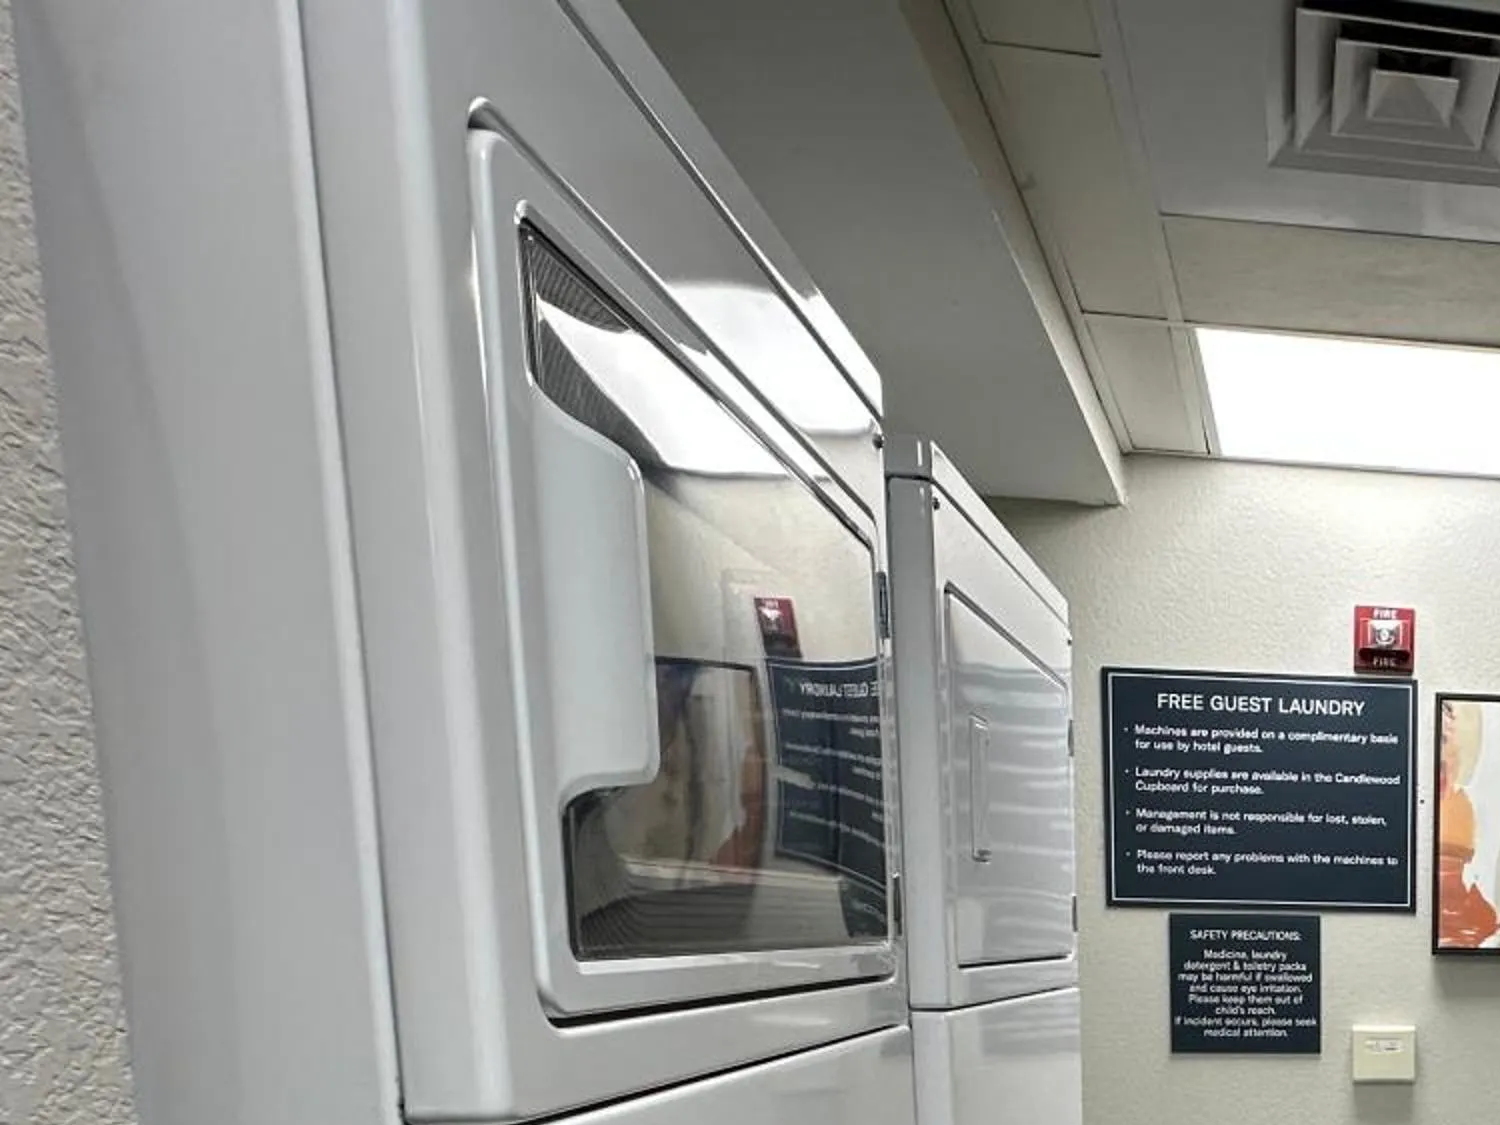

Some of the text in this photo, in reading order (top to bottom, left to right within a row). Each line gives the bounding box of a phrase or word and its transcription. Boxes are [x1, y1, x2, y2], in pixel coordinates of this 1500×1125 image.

[1373, 608, 1398, 619] FIRE
[1373, 656, 1397, 667] FIRE
[1157, 693, 1365, 716] FREE GUEST LAUNDRY
[1135, 724, 1398, 745] Machines are provided on a complimentary basis
[1135, 739, 1264, 755] for use by hotel guests.
[1135, 766, 1401, 785] Laundry supplies are available in the Candlewood
[1135, 780, 1264, 796] Cupboard for purchase.
[1136, 808, 1387, 827] Management is not responsible for lost, stolen,
[1135, 822, 1237, 836] or damaged items.
[1137, 849, 1398, 865] Please report any problems with the machines to
[1137, 863, 1216, 875] the front desk.
[1190, 929, 1228, 940] SAFETY
[1189, 984, 1208, 993] and
[1210, 985, 1238, 993] cause
[1241, 985, 1257, 994] eye
